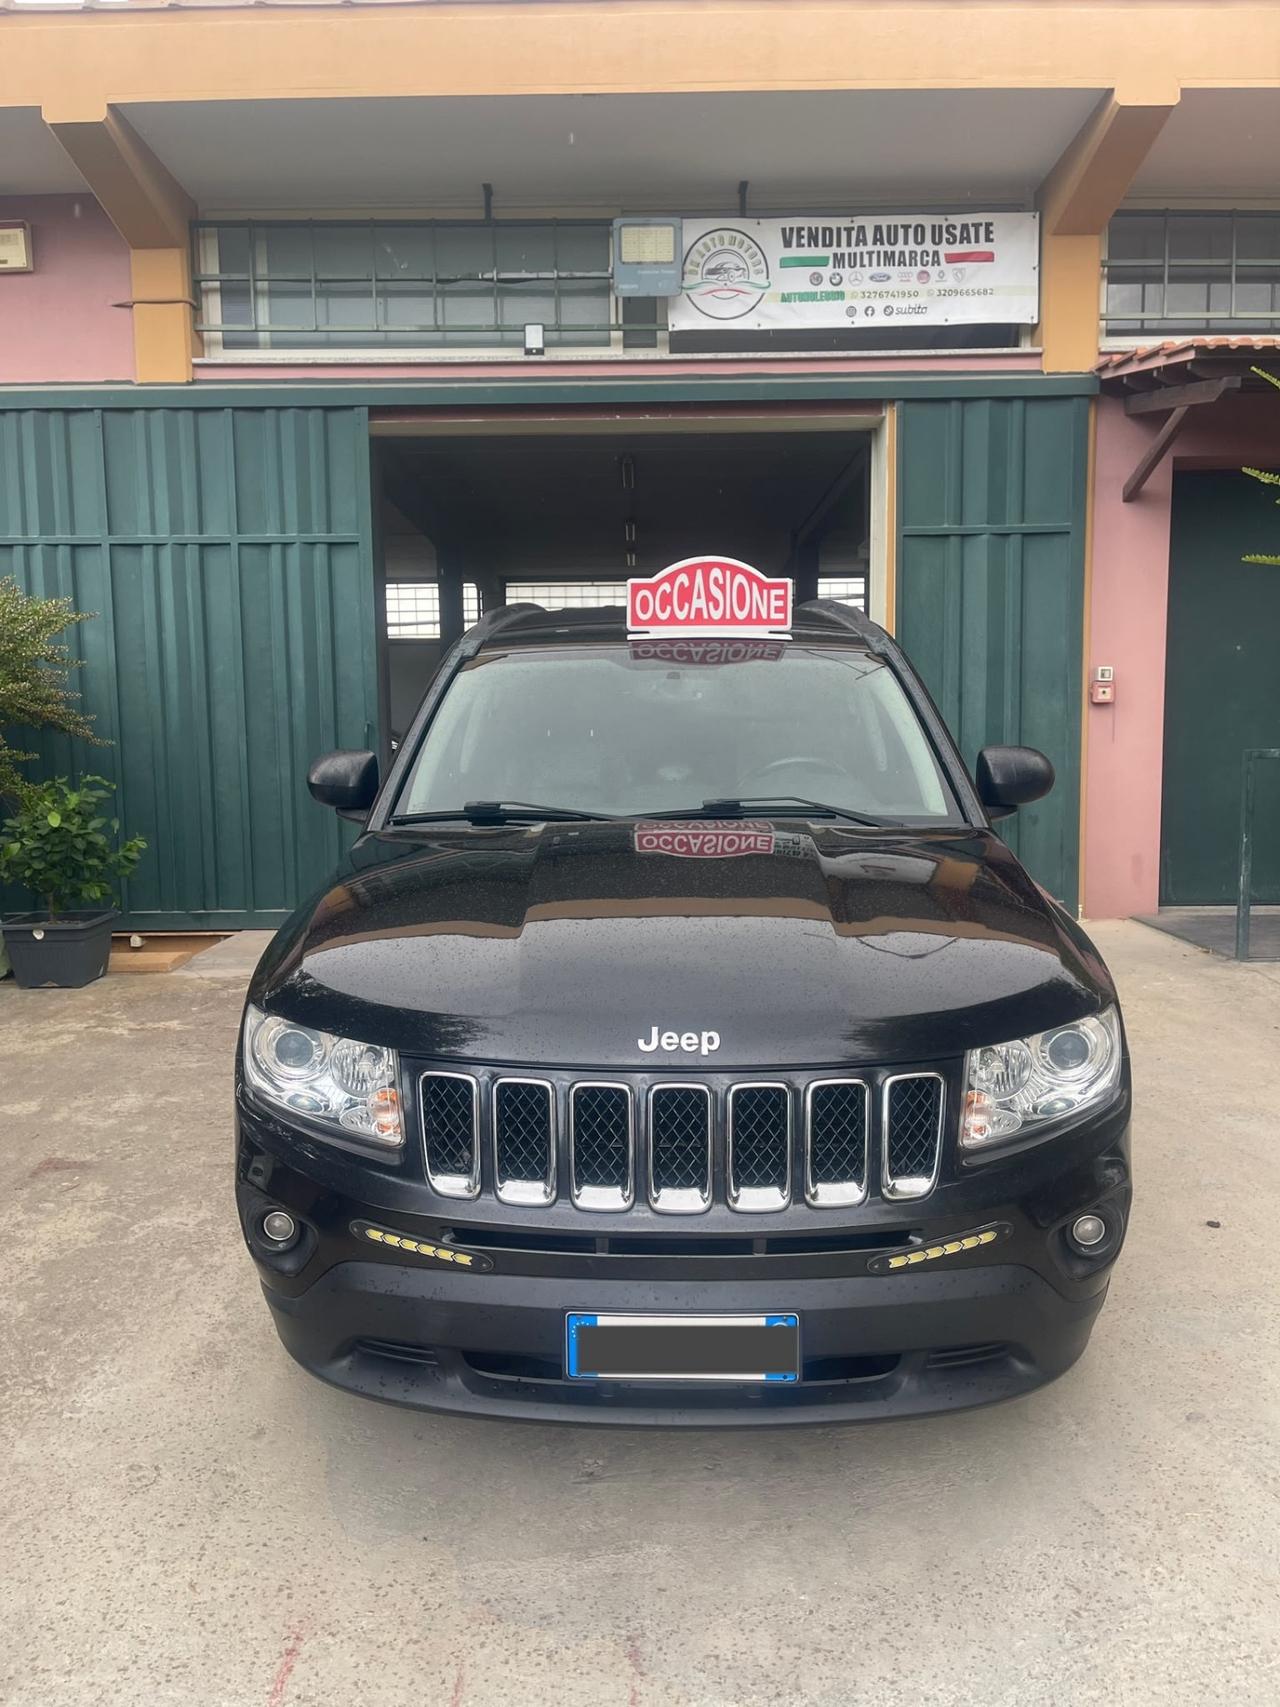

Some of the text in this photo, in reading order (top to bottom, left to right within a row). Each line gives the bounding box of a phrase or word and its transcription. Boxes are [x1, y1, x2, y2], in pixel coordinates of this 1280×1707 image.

[780, 222, 995, 248] VENDITA AUTO USATE
[832, 250, 941, 269] MULTIMARCA
[861, 290, 919, 299] 3276741950
[936, 288, 994, 297] 3209665682
[895, 304, 928, 315] subito
[635, 567, 785, 620] OCCASIONE
[637, 1026, 721, 1056] Jeep
